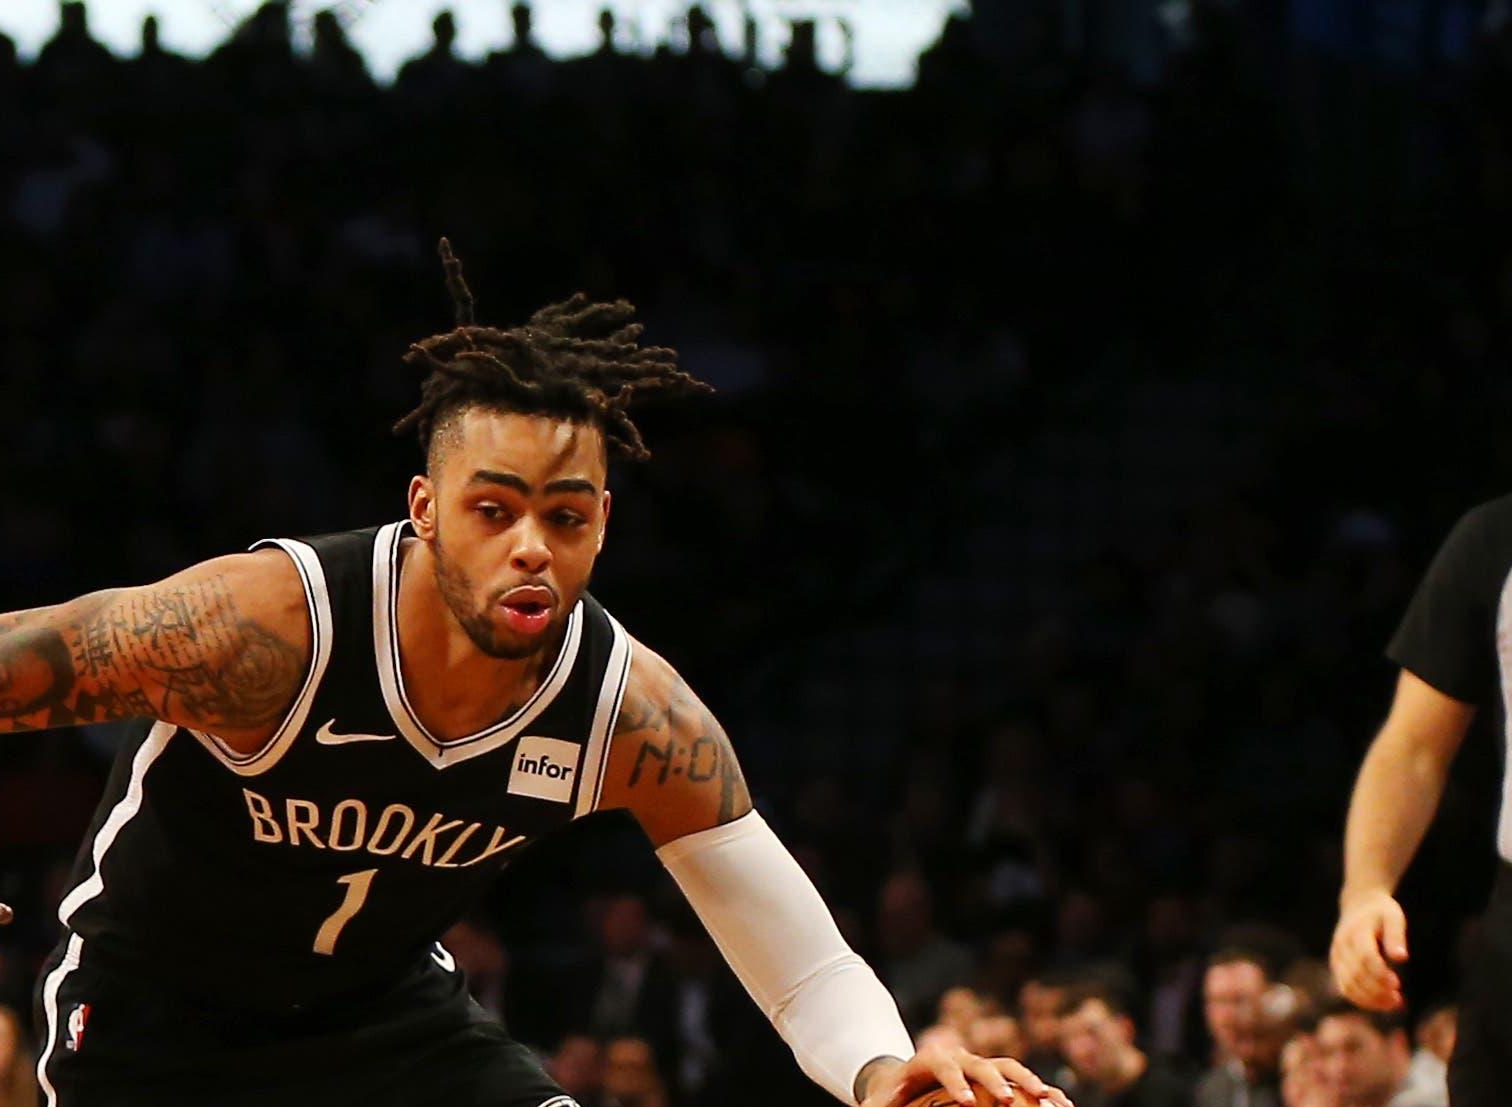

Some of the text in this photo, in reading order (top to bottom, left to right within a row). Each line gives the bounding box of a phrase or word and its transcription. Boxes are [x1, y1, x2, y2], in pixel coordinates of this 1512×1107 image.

[517, 753, 573, 781] infor
[242, 788, 526, 868] BROOKLY
[312, 868, 379, 956] 1
